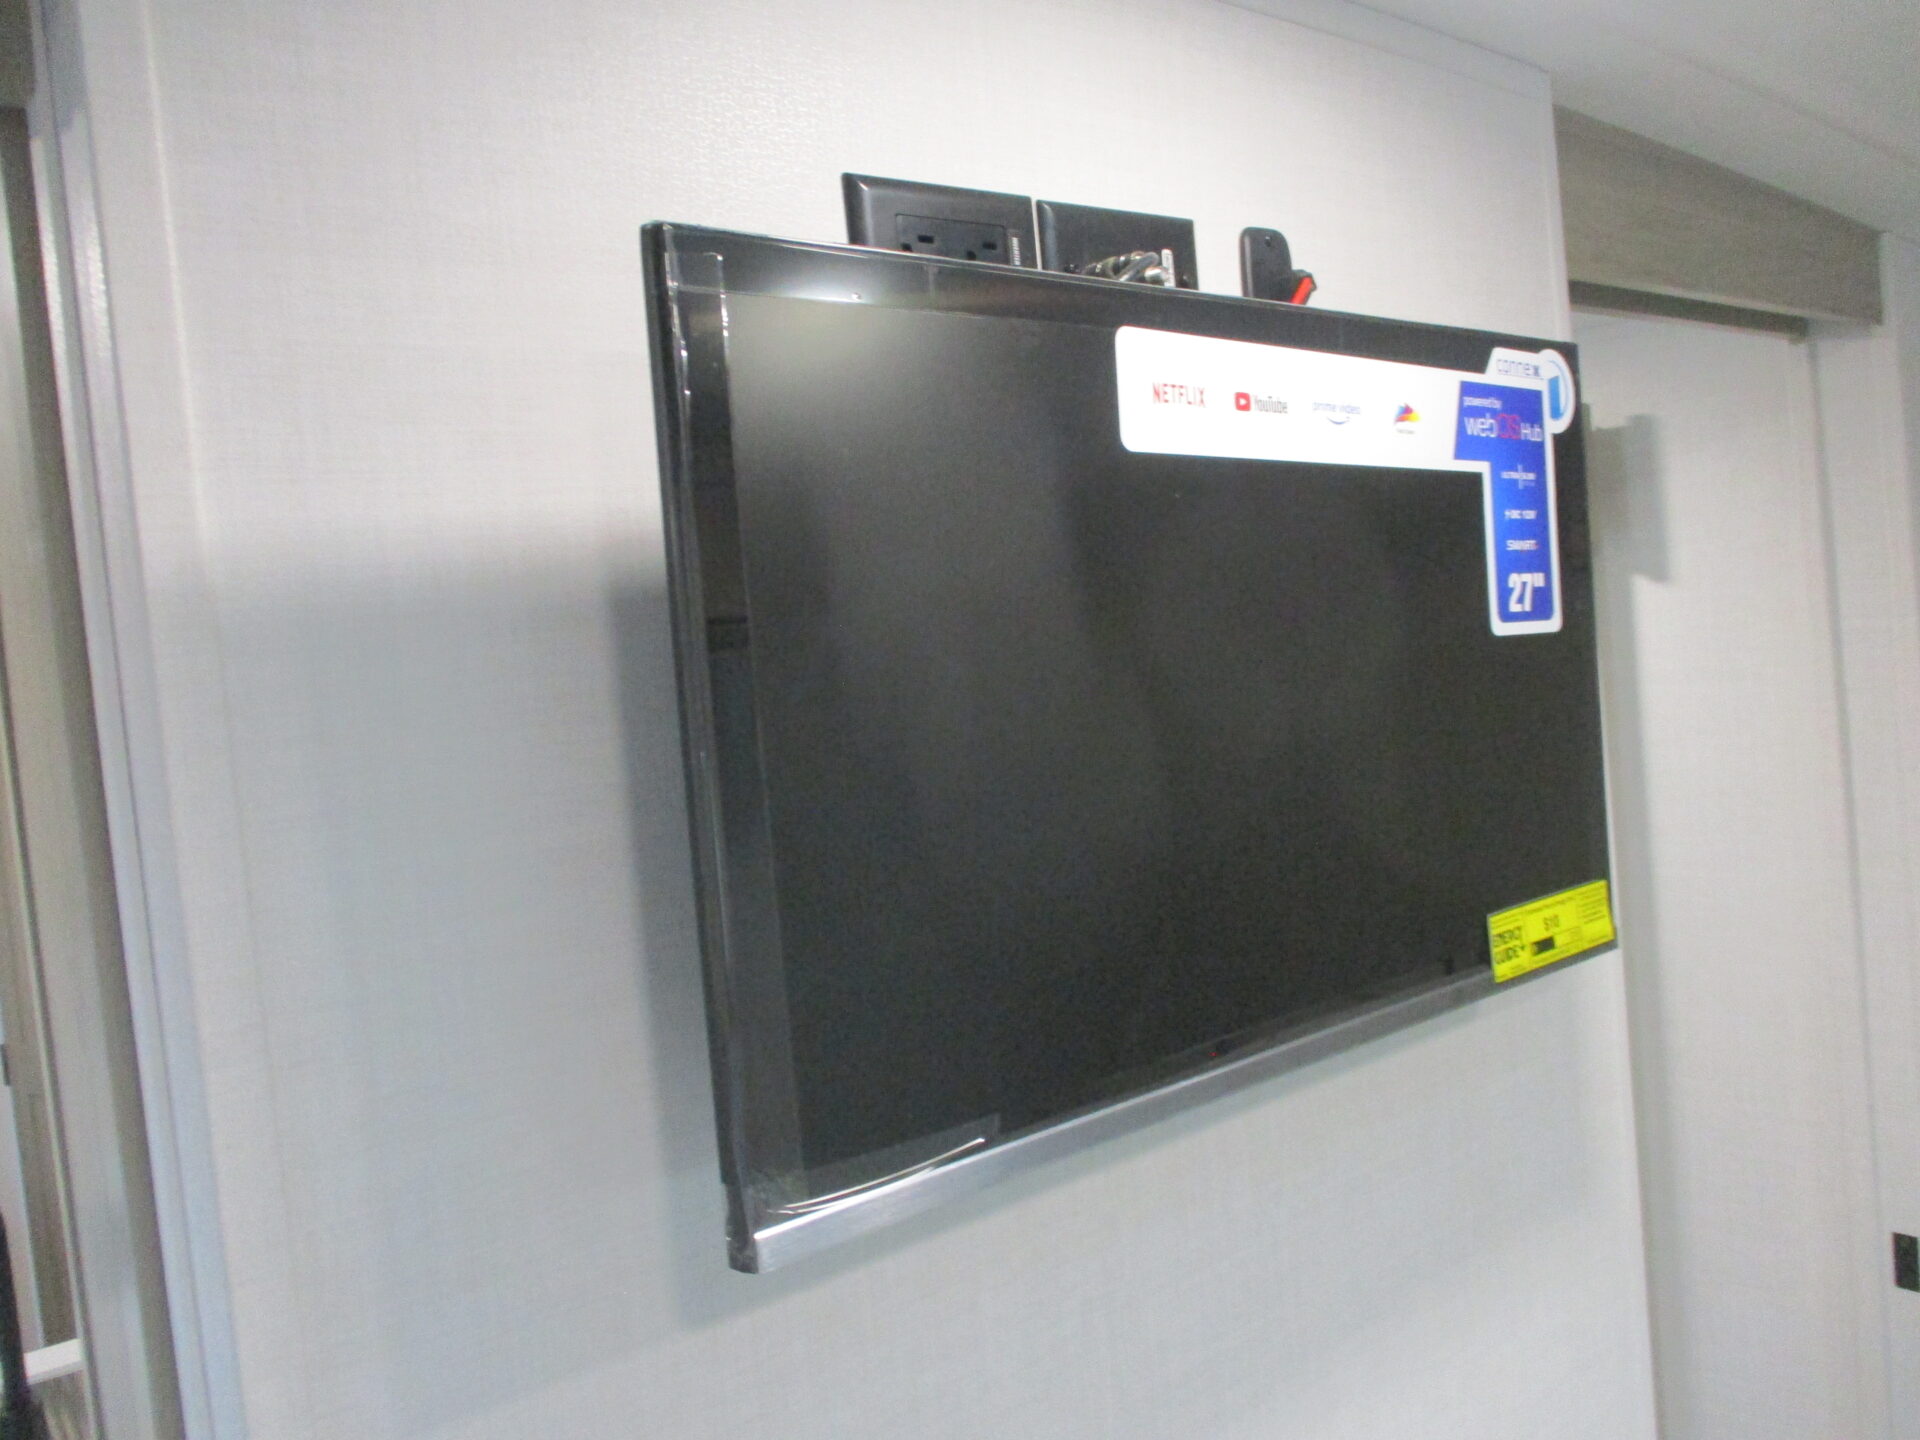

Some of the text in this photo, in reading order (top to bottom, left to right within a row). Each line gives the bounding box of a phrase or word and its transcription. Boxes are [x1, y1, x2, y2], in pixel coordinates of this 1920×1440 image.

[1153, 382, 1207, 407] NETFLIX
[1253, 395, 1288, 414] YouTube
[1508, 573, 1545, 612] 27"
